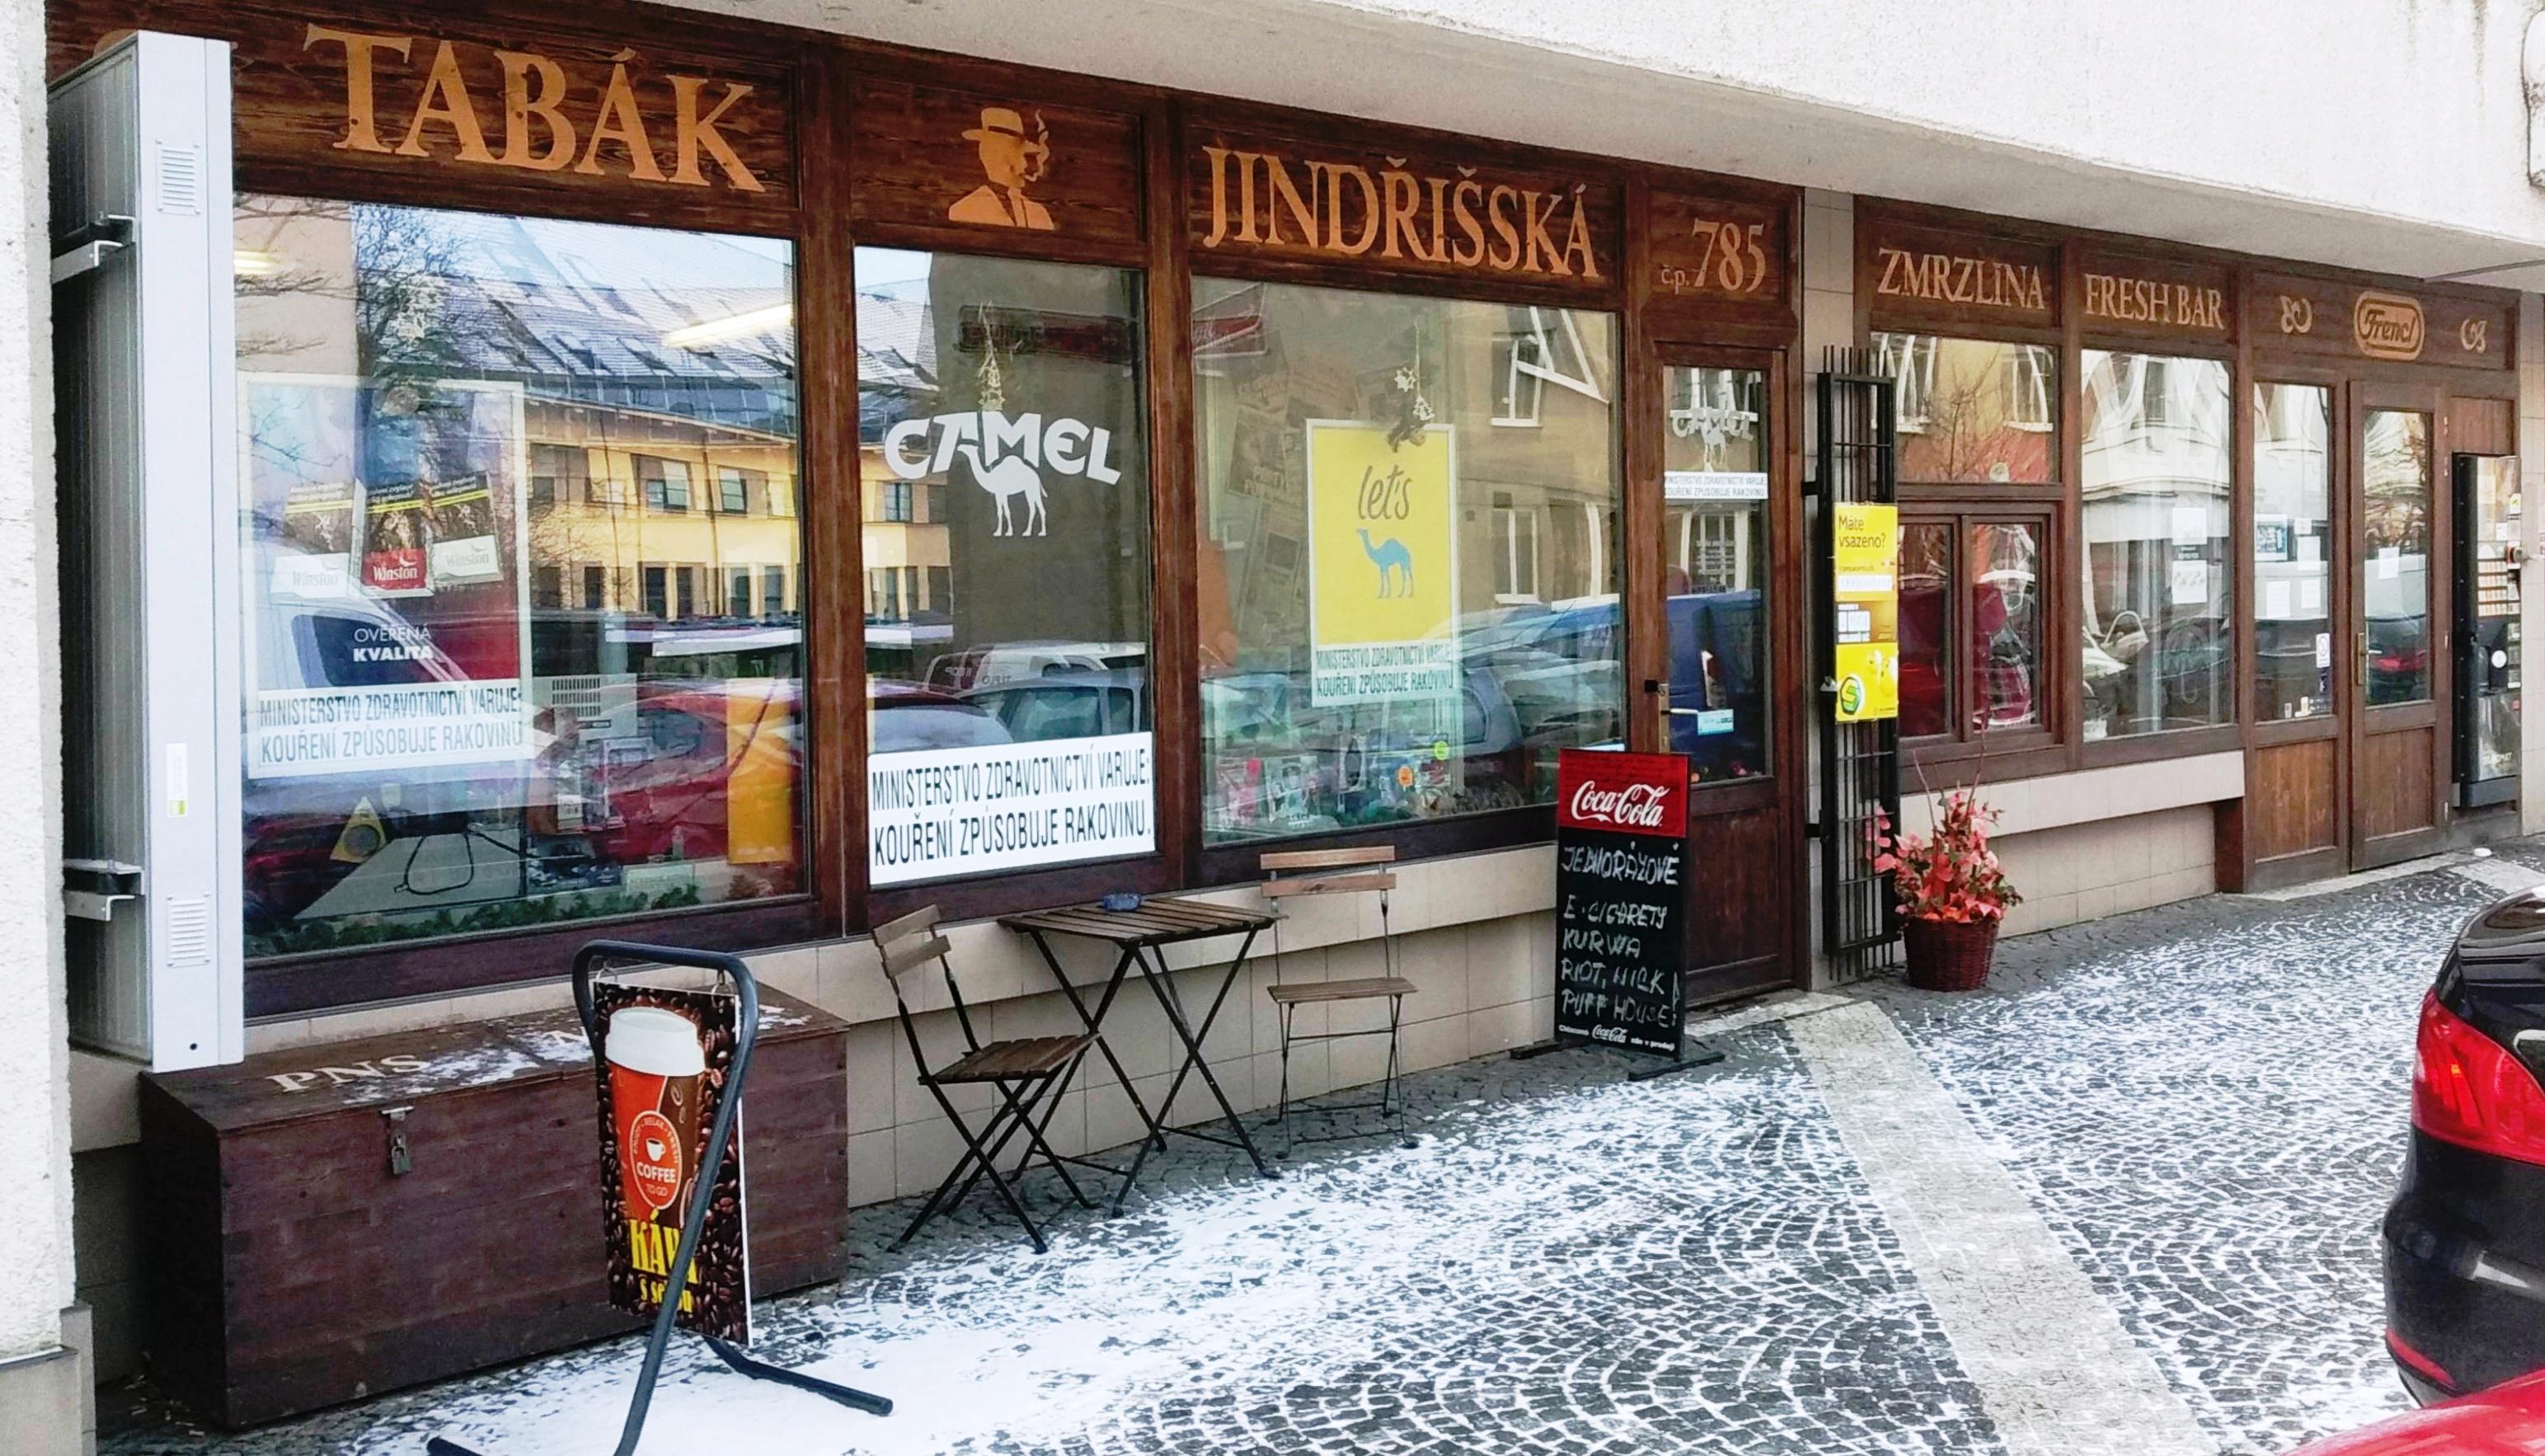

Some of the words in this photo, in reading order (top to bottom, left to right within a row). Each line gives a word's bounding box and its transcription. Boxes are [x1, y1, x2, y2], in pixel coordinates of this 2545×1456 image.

[303, 23, 766, 192] TABÁK
[1203, 145, 1599, 278] JINDŘIŠSKÁ
[1692, 217, 1767, 293] 785
[1877, 247, 2045, 310] ZMRZLINA
[2085, 274, 2170, 323] FRESH
[2176, 285, 2225, 330] BAR
[884, 411, 1121, 486] CAMEL
[1838, 514, 1864, 531] Máte
[1838, 533, 1886, 548] vsazeno?
[373, 566, 418, 581] Winston
[445, 553, 490, 566] Winston
[353, 646, 434, 662] KVALITA
[1317, 672, 1356, 697] KOUŘENÍ
[259, 694, 361, 727] MINISTERSTVO
[365, 685, 467, 721] ZDRAVOTNICTVÍ
[261, 727, 337, 763] KOUŘENÍ
[342, 724, 436, 758] ZPŮSOBUJE
[872, 762, 980, 811] MINISTERSTVO
[985, 743, 1094, 801] ZDRAVOTNICTVÍ
[1097, 748, 1150, 789] VARUJE:
[1571, 780, 1670, 827] Coca-Cola
[874, 808, 956, 867] KOUŘENÍ
[960, 805, 1059, 856] ZPŮSOBUJE
[1065, 799, 1151, 844] RAKOVINU.
[1561, 841, 1680, 885] JEDNORÁZOVÉ
[1562, 928, 1641, 959] KURWA
[1561, 988, 1608, 1017] PUFF
[265, 1053, 432, 1094] PNS
[636, 1161, 676, 1184] COFFEE
